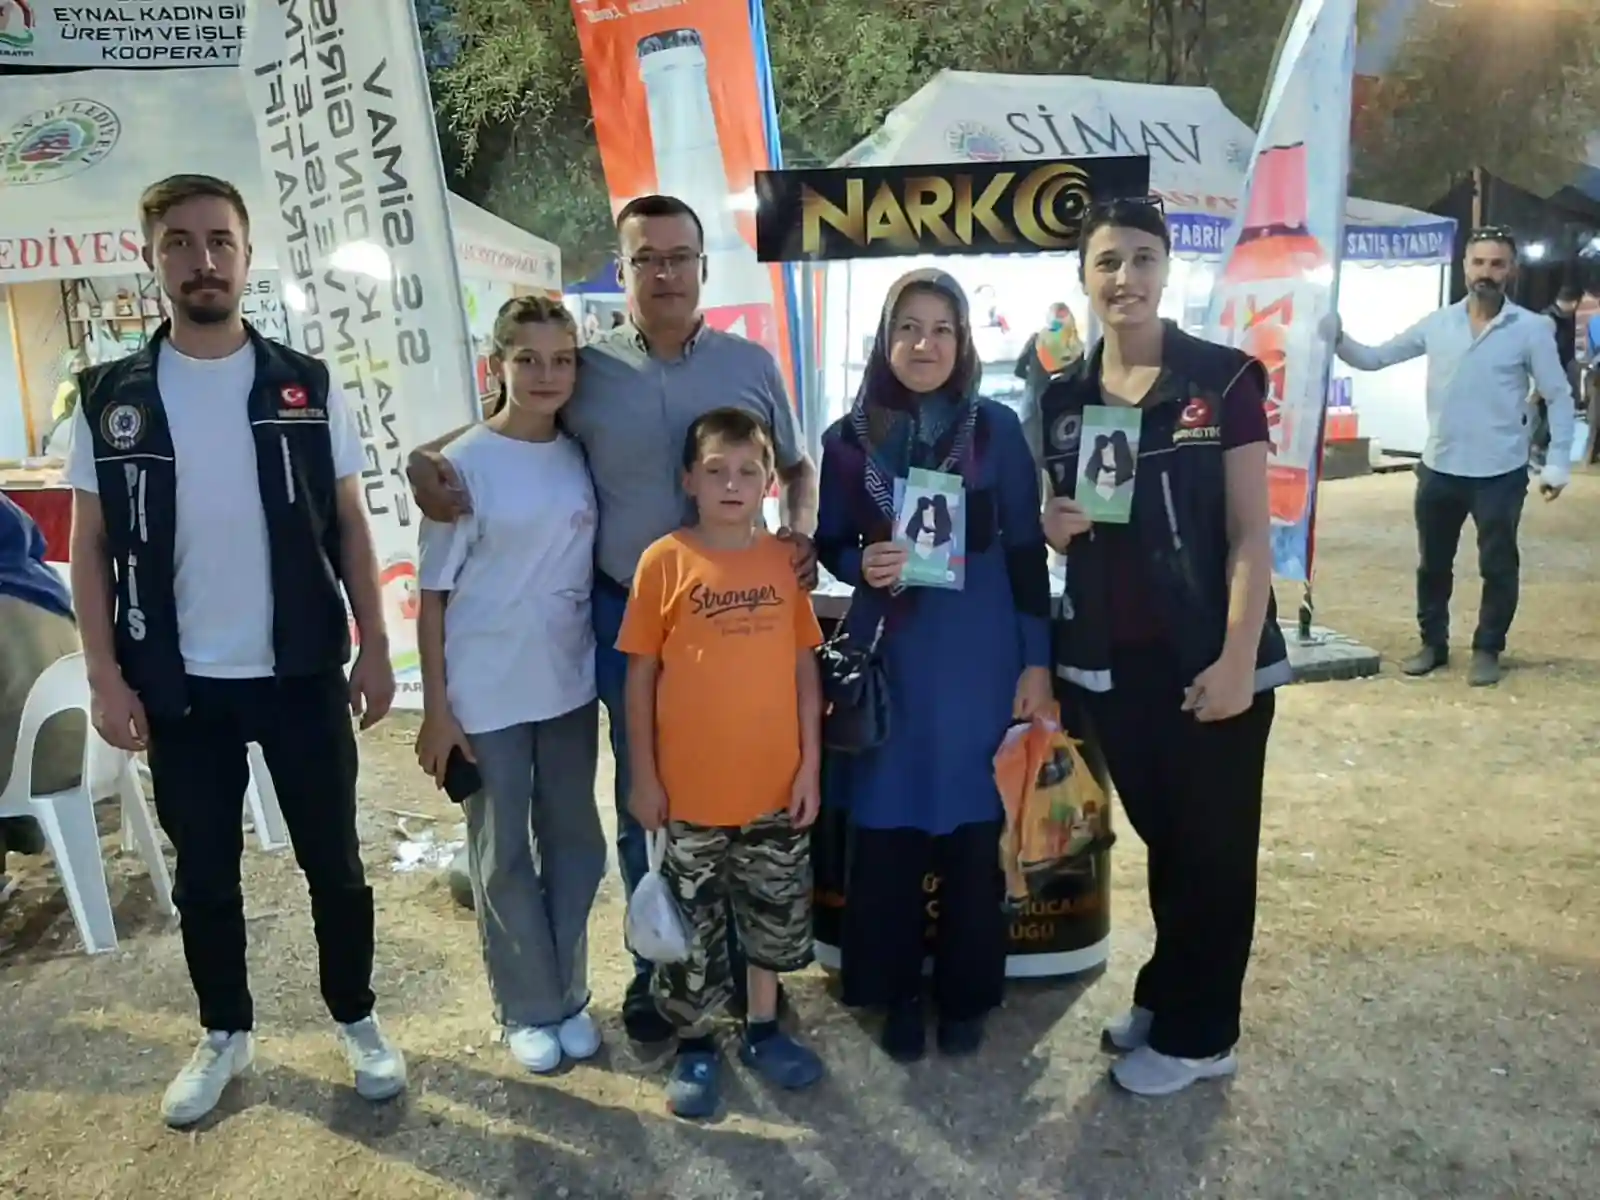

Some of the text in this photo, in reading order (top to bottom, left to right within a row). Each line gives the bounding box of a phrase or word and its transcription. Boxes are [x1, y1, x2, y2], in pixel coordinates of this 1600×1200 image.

[53, 4, 246, 22] EYNAL KADIN Gİ
[61, 24, 154, 41] ÜRETİM
[157, 27, 191, 41] VE
[1005, 103, 1202, 165] SİMAV
[689, 583, 784, 615] Stronger
